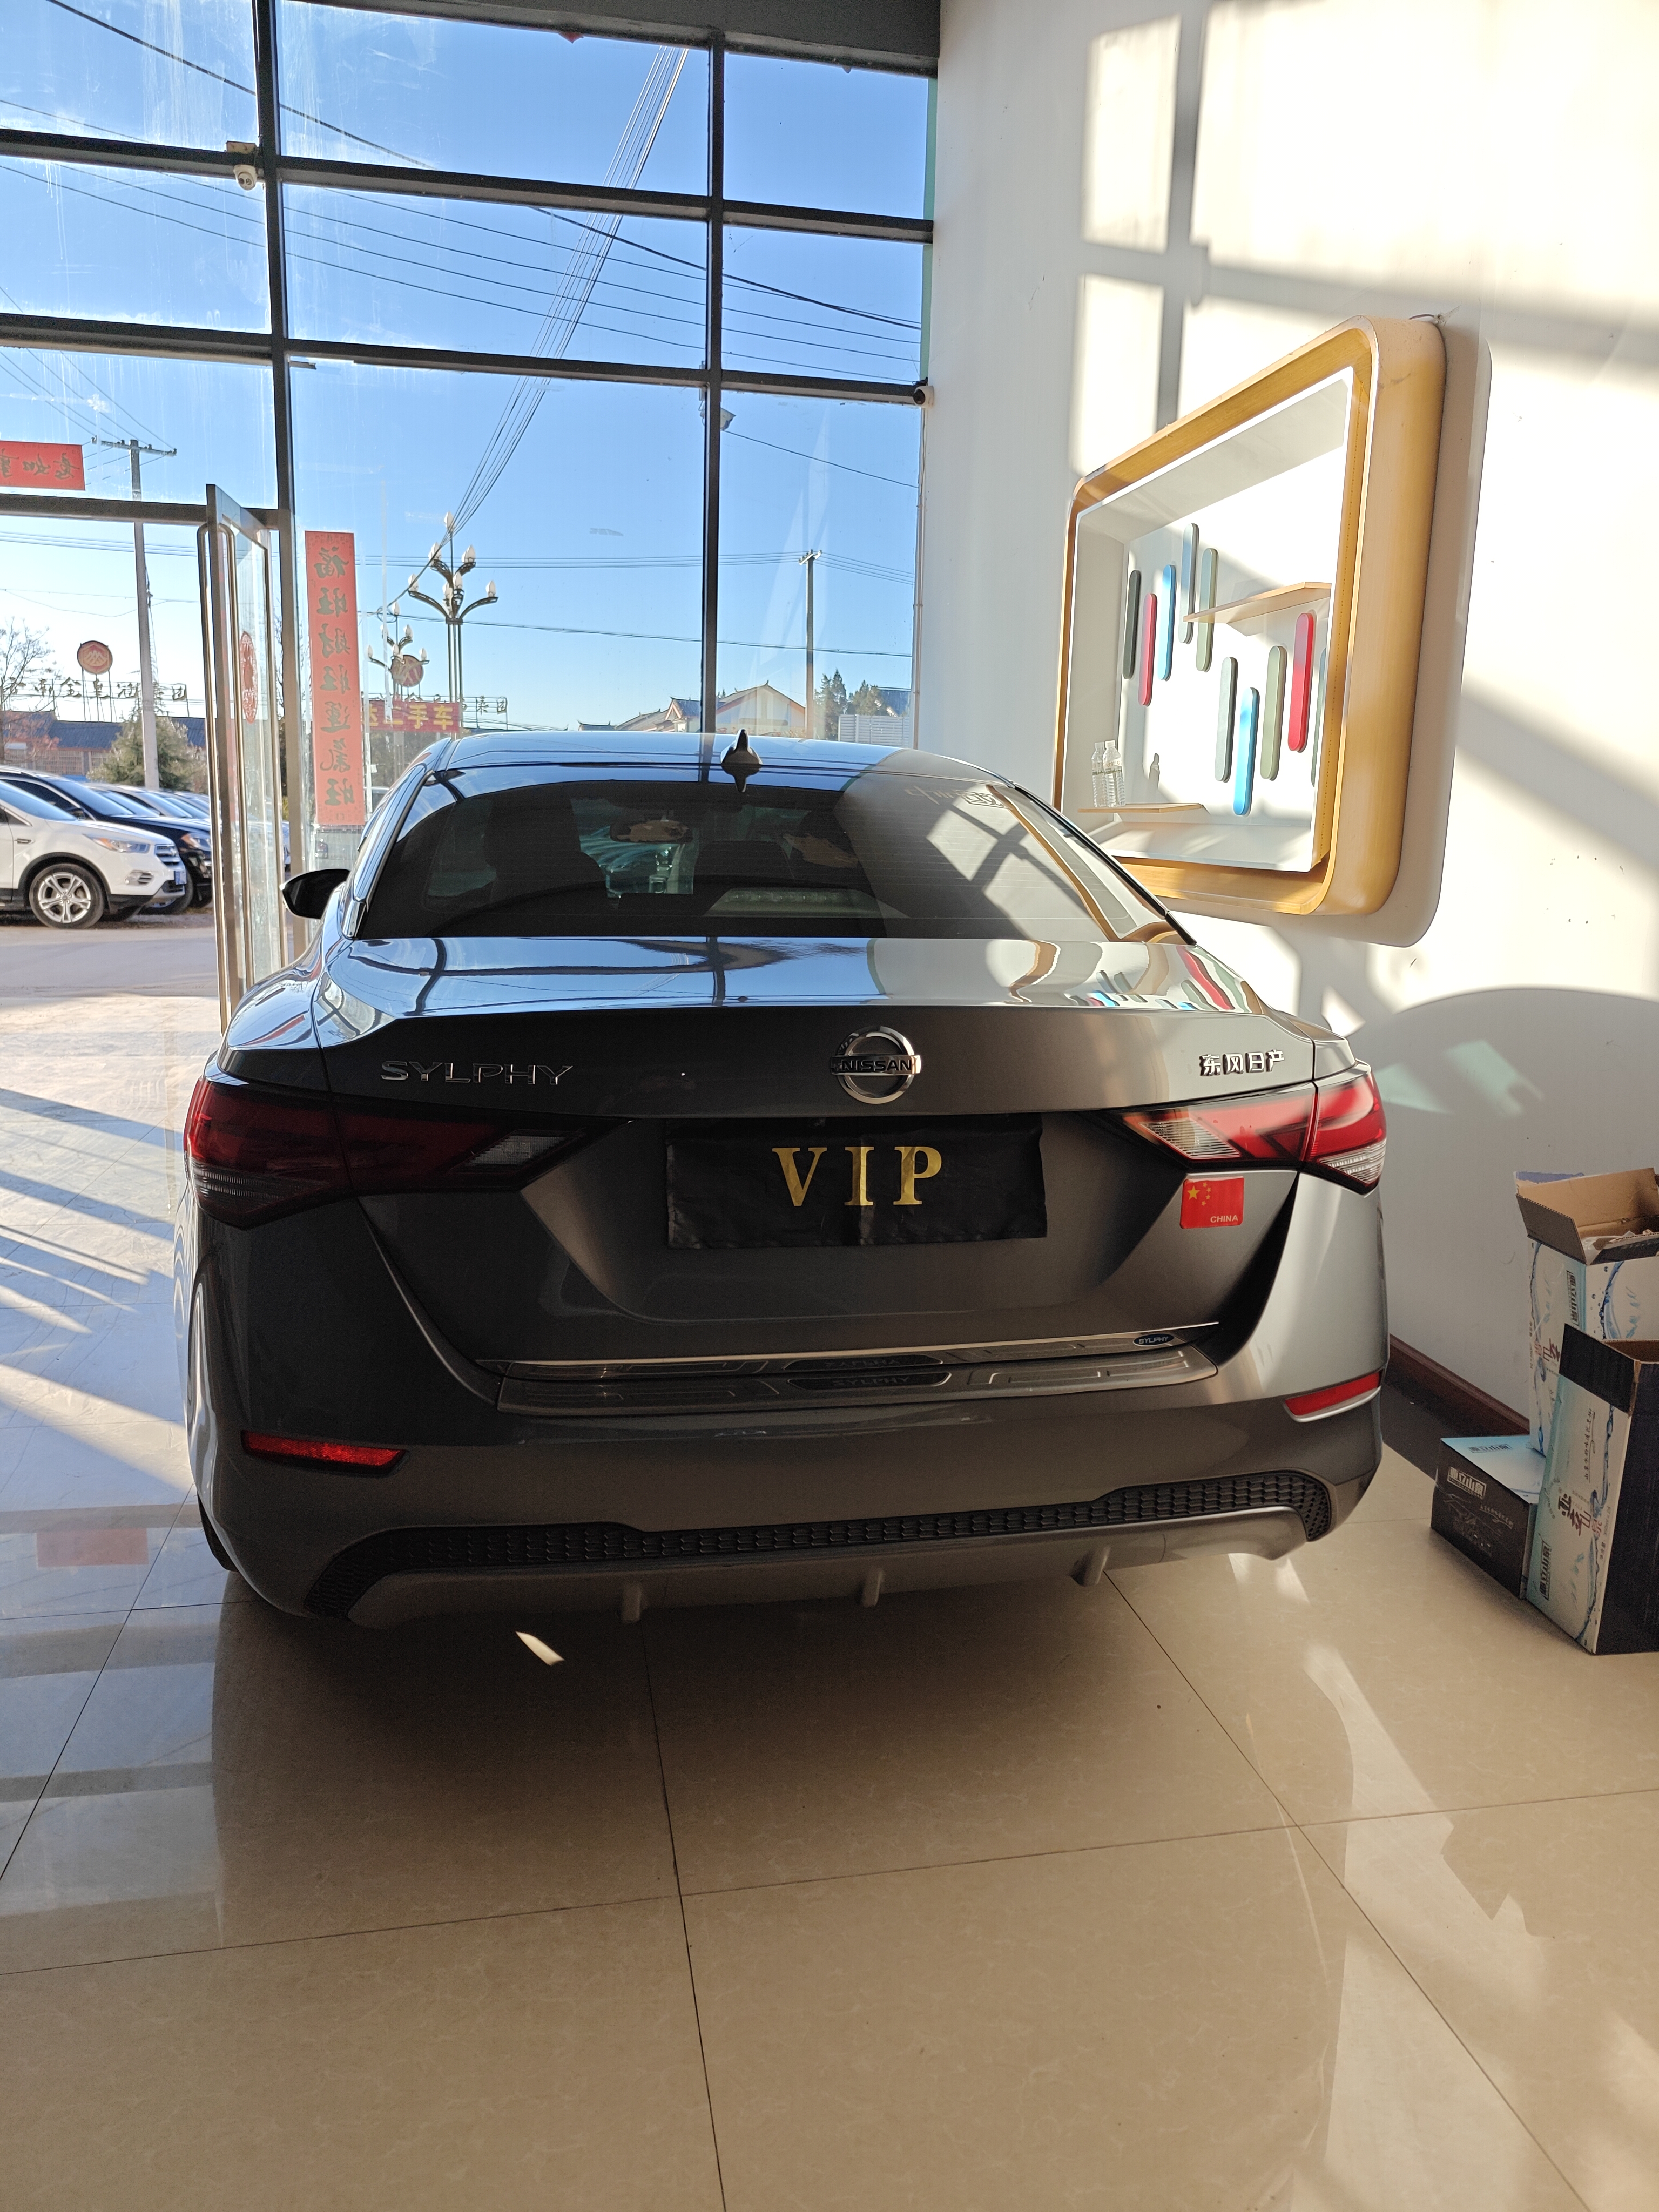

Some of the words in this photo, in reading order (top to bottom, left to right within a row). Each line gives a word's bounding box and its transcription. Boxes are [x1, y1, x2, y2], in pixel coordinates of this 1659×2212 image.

[841, 1059, 912, 1071] NISSAN
[1199, 1049, 1285, 1076] 东风日产
[381, 1061, 573, 1085] SYLPHY
[772, 1145, 942, 1207] VIP
[1210, 1215, 1239, 1223] CHINA
[1138, 1336, 1169, 1344] SYLPHY
[833, 1377, 908, 1386] SYLPHY
[1449, 1466, 1484, 1497] 亚立山泉
